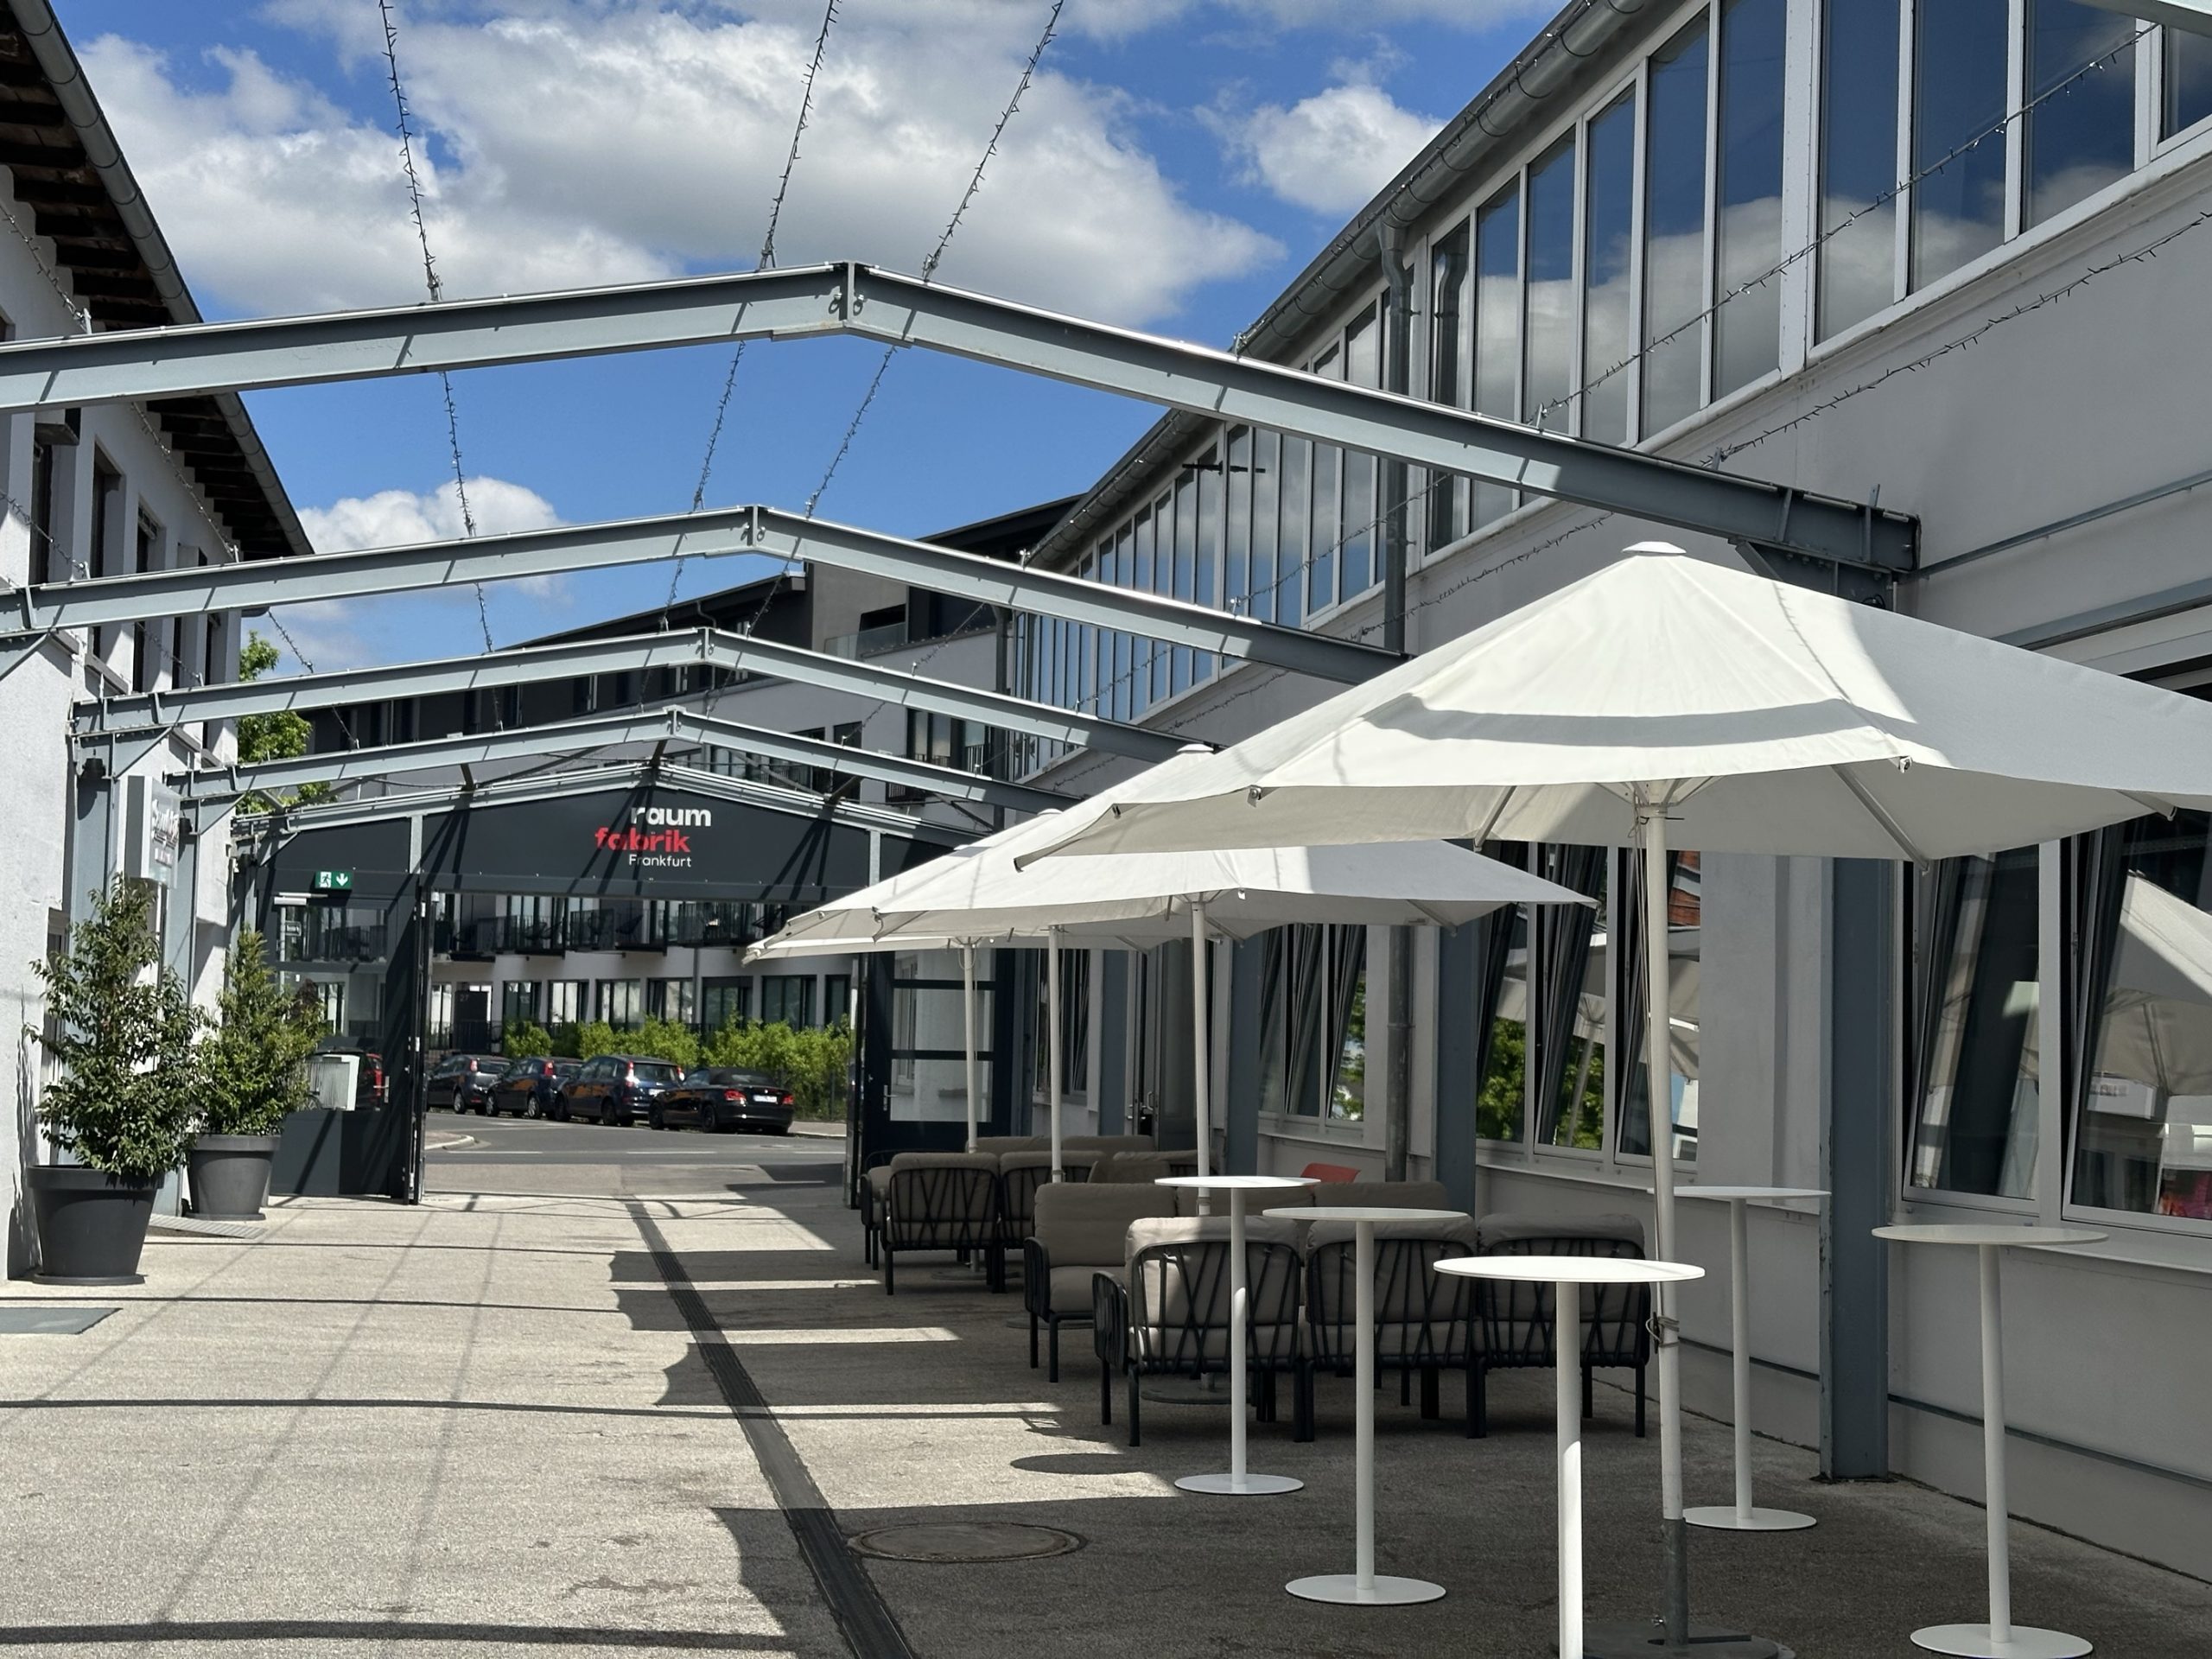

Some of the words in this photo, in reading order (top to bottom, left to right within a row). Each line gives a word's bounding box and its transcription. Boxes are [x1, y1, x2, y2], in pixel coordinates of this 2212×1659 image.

[631, 807, 712, 827] raum
[594, 827, 690, 853] fabrik
[629, 854, 691, 868] Frankfurt
